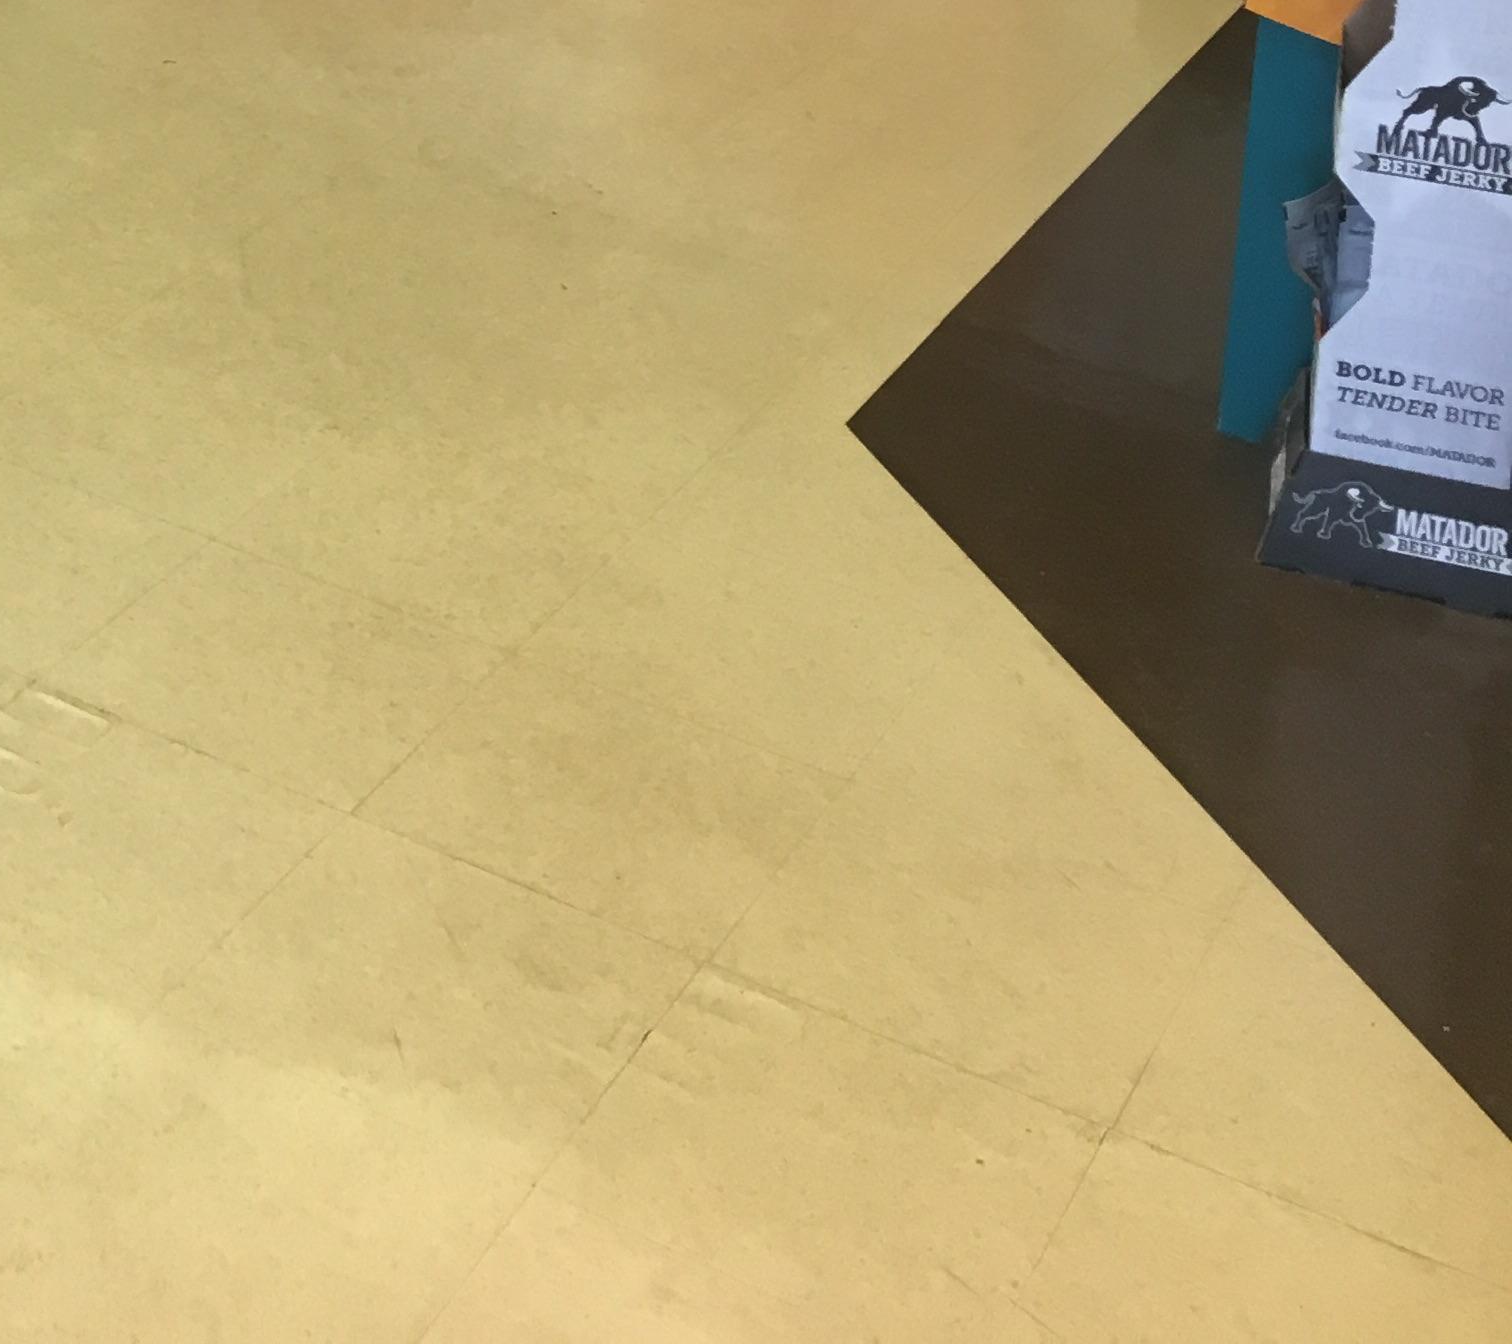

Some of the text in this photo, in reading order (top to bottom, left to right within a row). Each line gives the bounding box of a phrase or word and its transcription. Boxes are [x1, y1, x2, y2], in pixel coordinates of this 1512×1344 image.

[1377, 124, 1511, 175] MATADOR
[1378, 158, 1507, 192] BEEF JERKY
[1336, 361, 1504, 406] BOLD FLAVOR
[1337, 386, 1501, 431] TENDER BITE
[1335, 429, 1496, 469] facebook.com/MATADOR
[1396, 508, 1508, 556] MATADOR
[1397, 538, 1504, 572] BEEF JERKY
